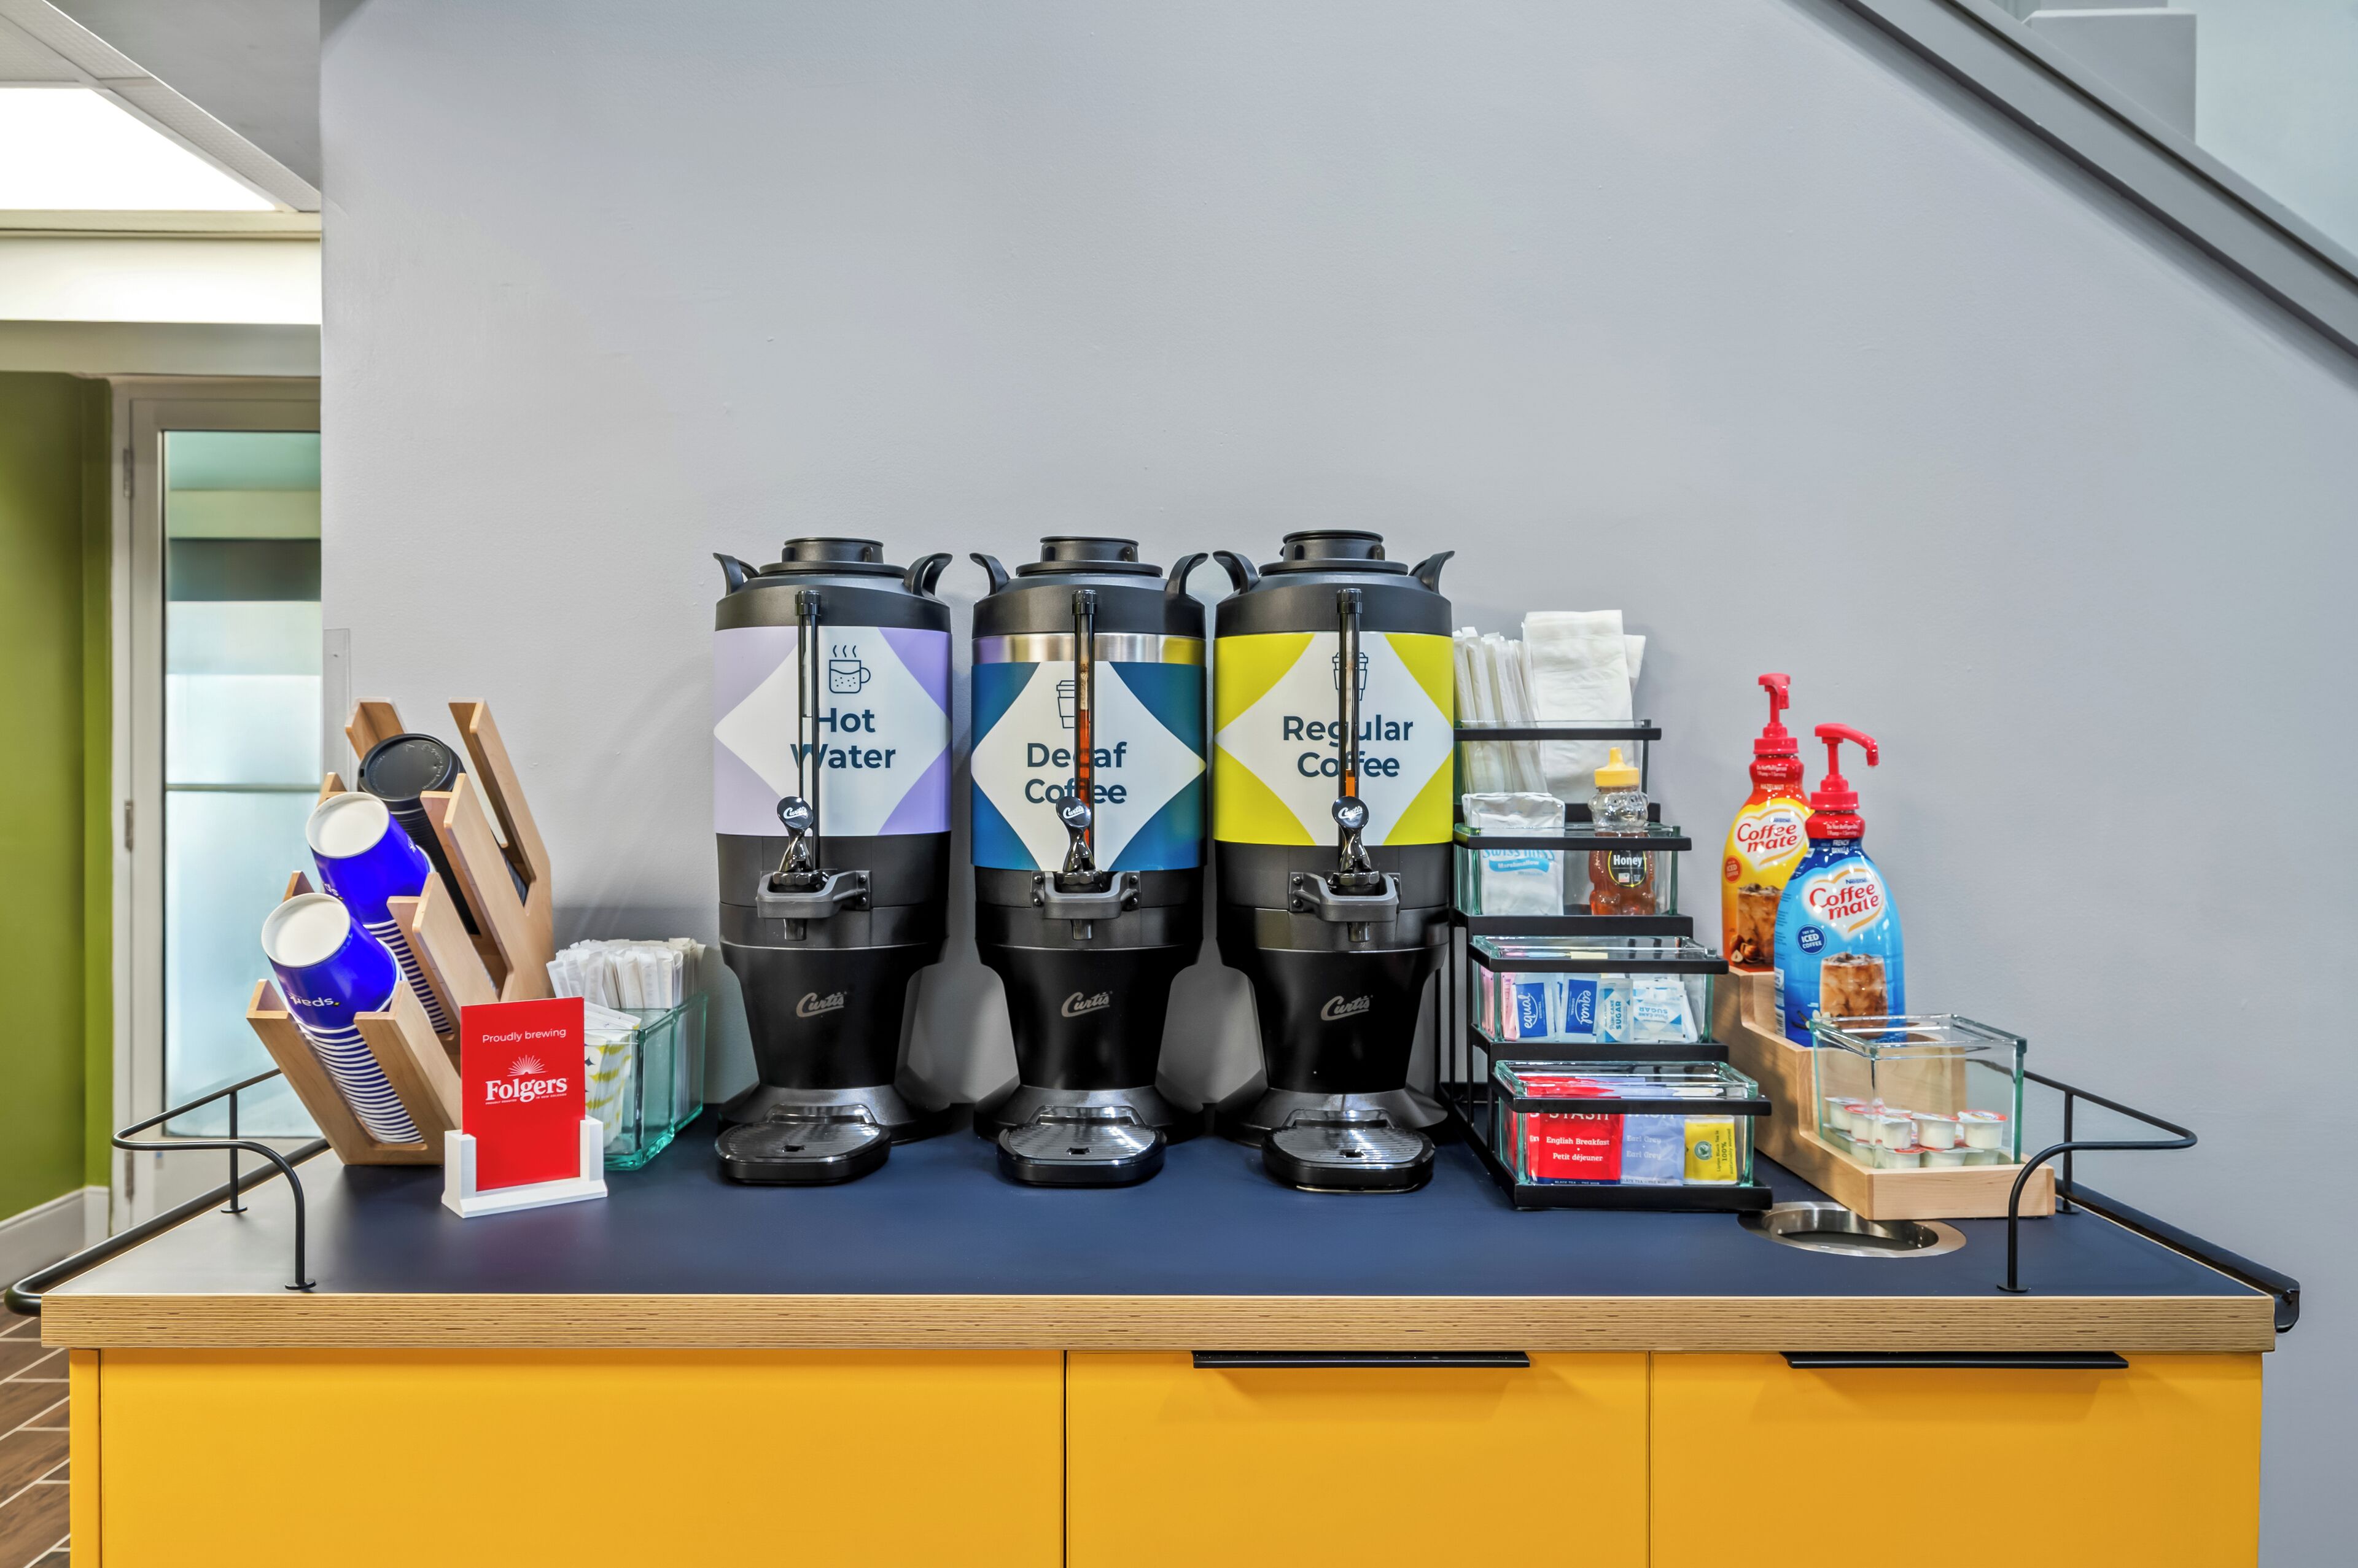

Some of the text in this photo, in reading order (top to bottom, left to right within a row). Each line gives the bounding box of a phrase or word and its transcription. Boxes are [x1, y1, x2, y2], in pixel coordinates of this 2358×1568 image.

[817, 707, 876, 733] Hot
[1283, 715, 1414, 747] Regular
[790, 743, 897, 769] Water
[1027, 741, 1127, 767] Deaf
[1025, 777, 1127, 804] Cofee
[1737, 823, 1797, 842] Coffee
[1747, 835, 1797, 853] mate
[1613, 855, 1643, 867] Honey
[1809, 884, 1875, 908] Coffee
[1828, 895, 1879, 920] mate
[1801, 933, 1819, 943] ICED
[1802, 940, 1823, 949] COFFEE
[796, 992, 844, 1017] Curtis
[1061, 992, 1110, 1017] Curtis
[1321, 995, 1370, 1021] Curtis
[1517, 993, 1536, 1029] equal
[1578, 990, 1593, 1025] equal
[483, 1028, 566, 1043] Proudly brewing
[485, 1078, 567, 1103] Folgers
[1546, 1136, 1573, 1145] English
[1571, 1154, 1603, 1162] déjeuner
